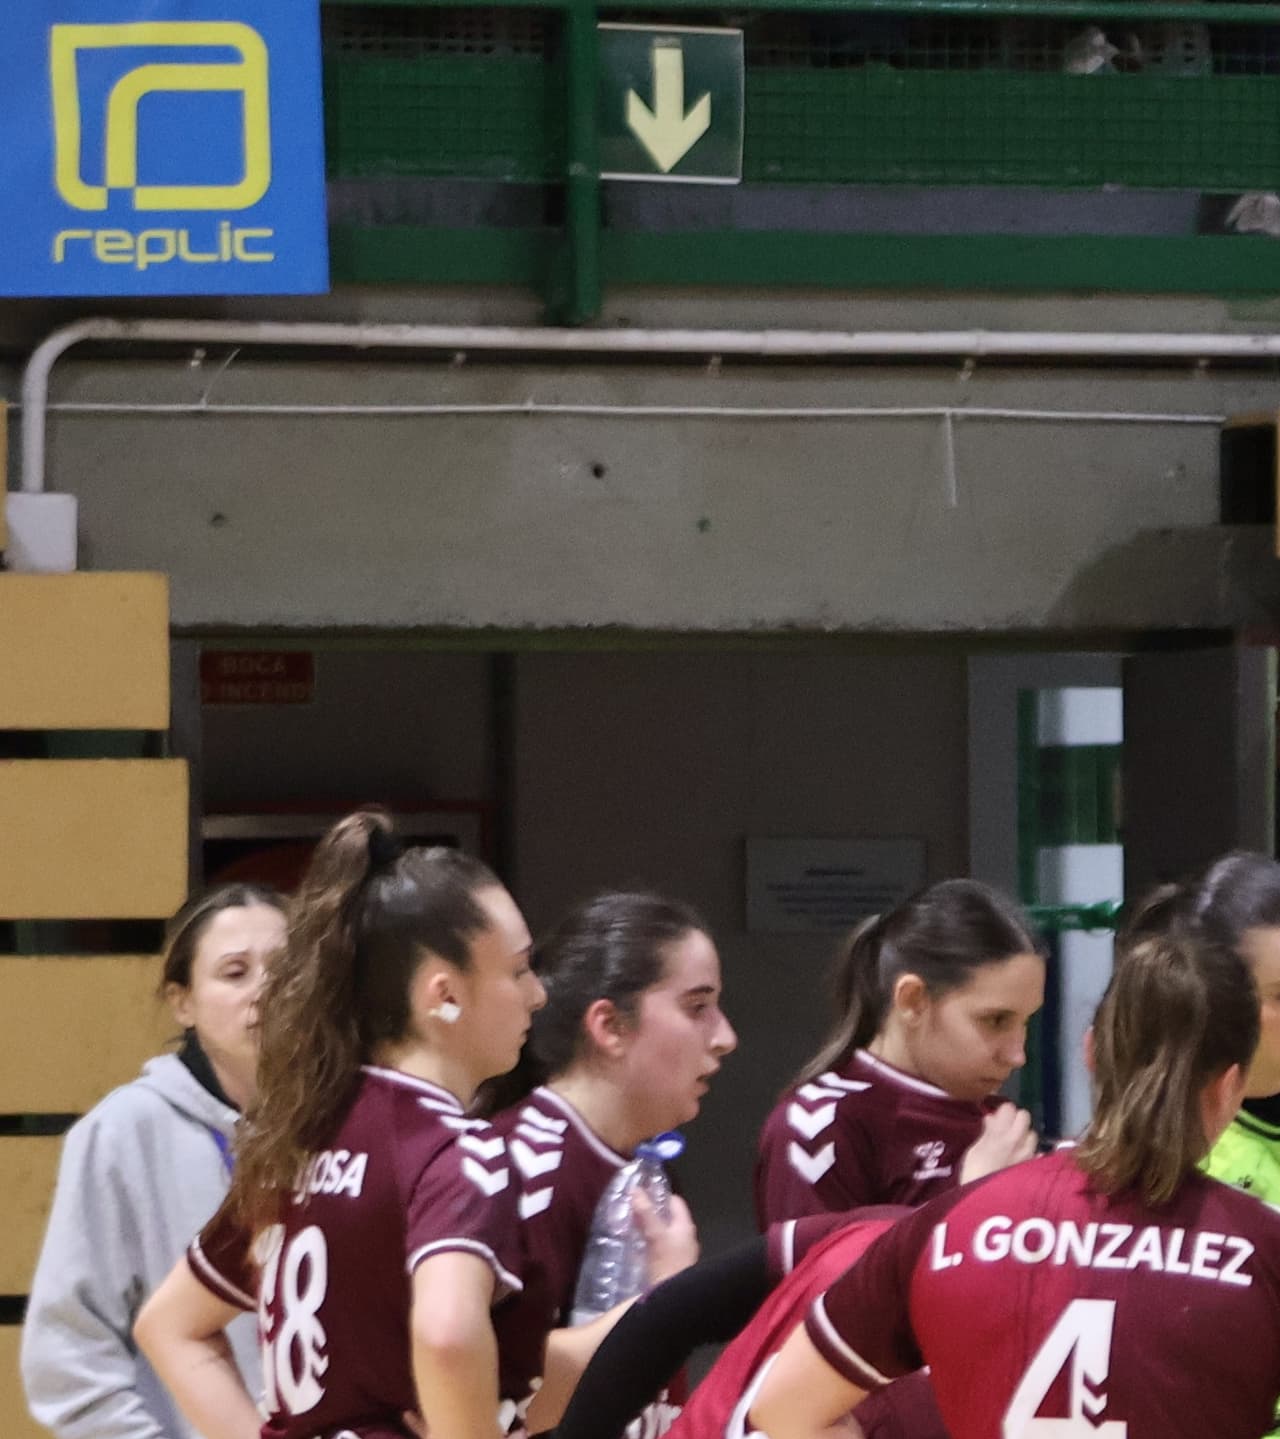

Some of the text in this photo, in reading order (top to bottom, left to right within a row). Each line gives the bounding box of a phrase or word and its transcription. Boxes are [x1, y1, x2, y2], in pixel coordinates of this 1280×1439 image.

[53, 220, 276, 271] replic
[930, 1215, 1256, 1287] L. GONZALEZ
